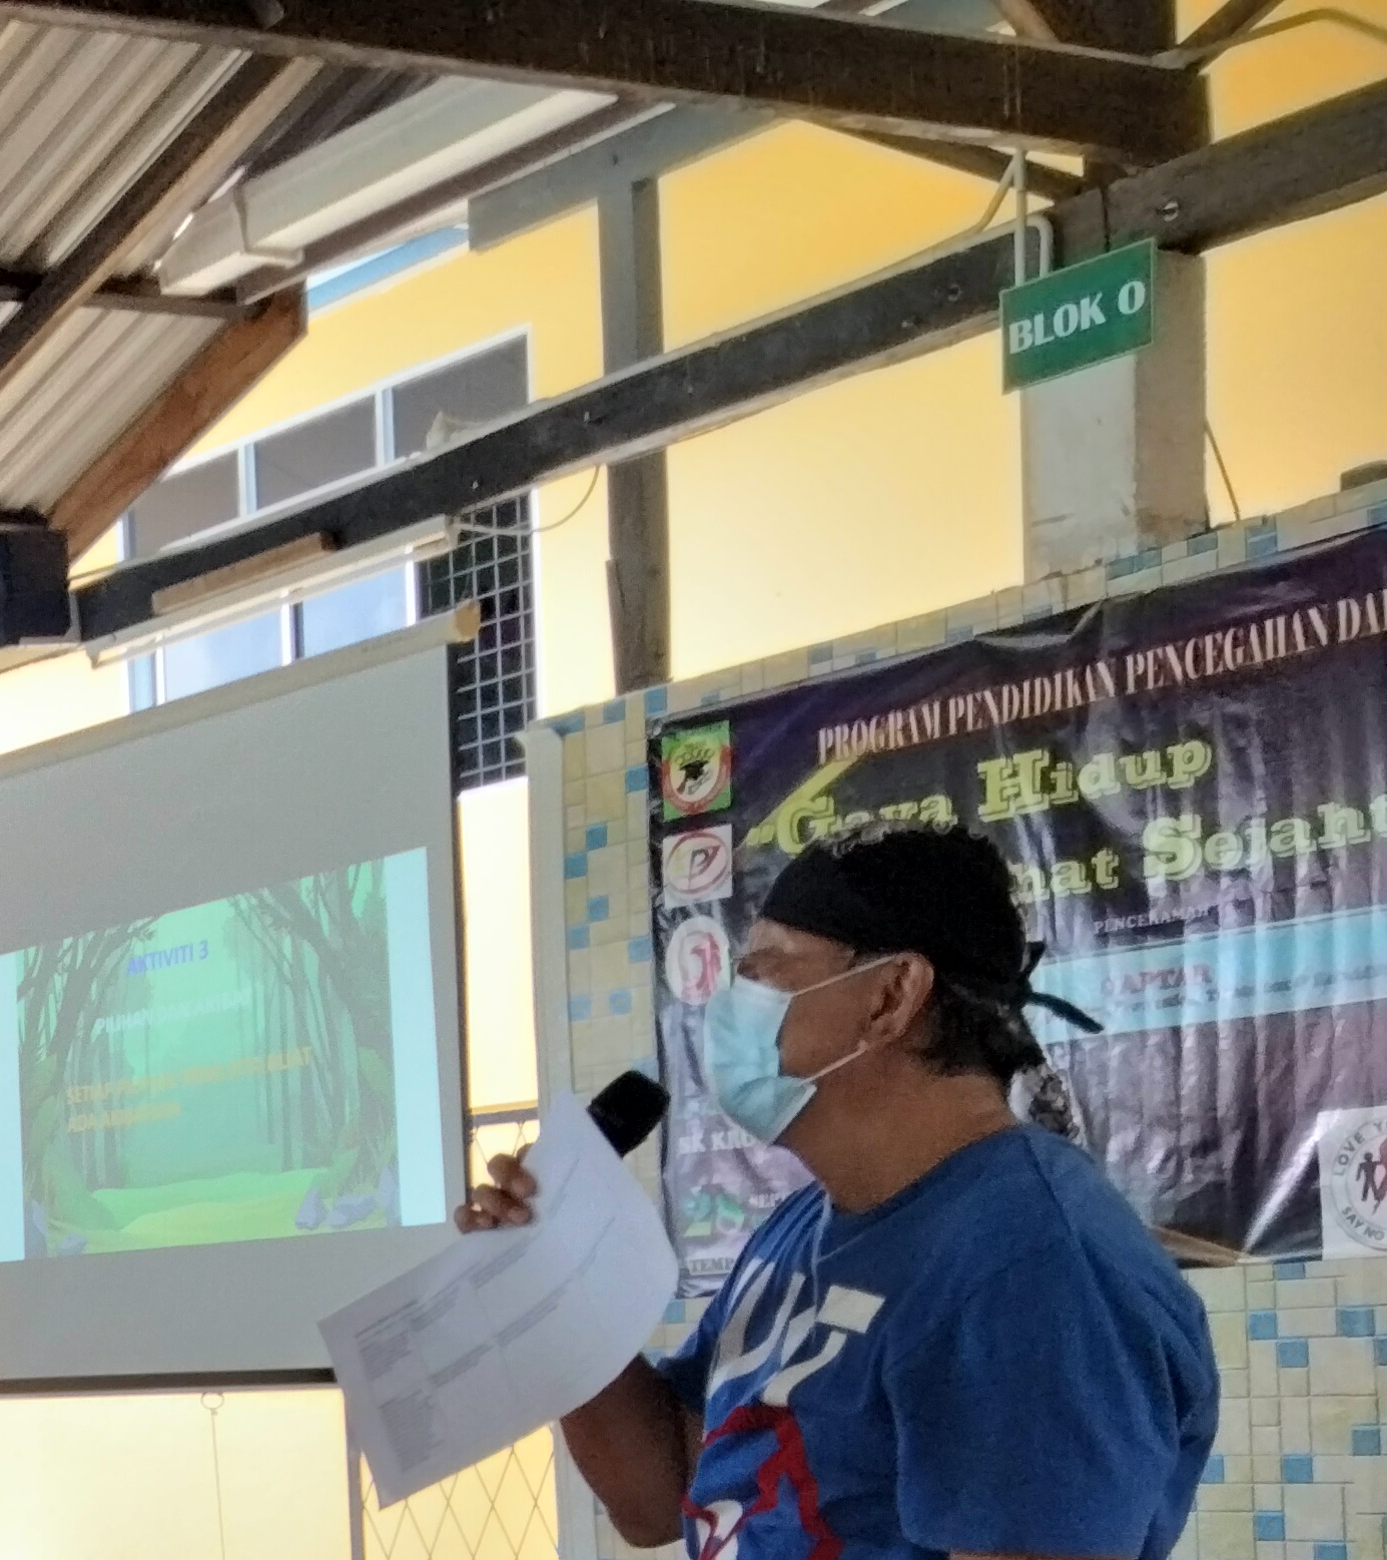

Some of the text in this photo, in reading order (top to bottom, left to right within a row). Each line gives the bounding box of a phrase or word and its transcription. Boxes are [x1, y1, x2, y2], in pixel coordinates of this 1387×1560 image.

[1009, 290, 1107, 355] BLOK
[817, 700, 941, 764] PROGRAM
[947, 661, 1116, 738] PENDIDIKAN
[1126, 603, 1328, 694] PENCEGAHAN
[976, 736, 1214, 821] Hidup
[127, 940, 209, 975] AKTIVITI 3
[1332, 1131, 1366, 1177] LOVE
[1341, 1205, 1385, 1241] SAY NO
